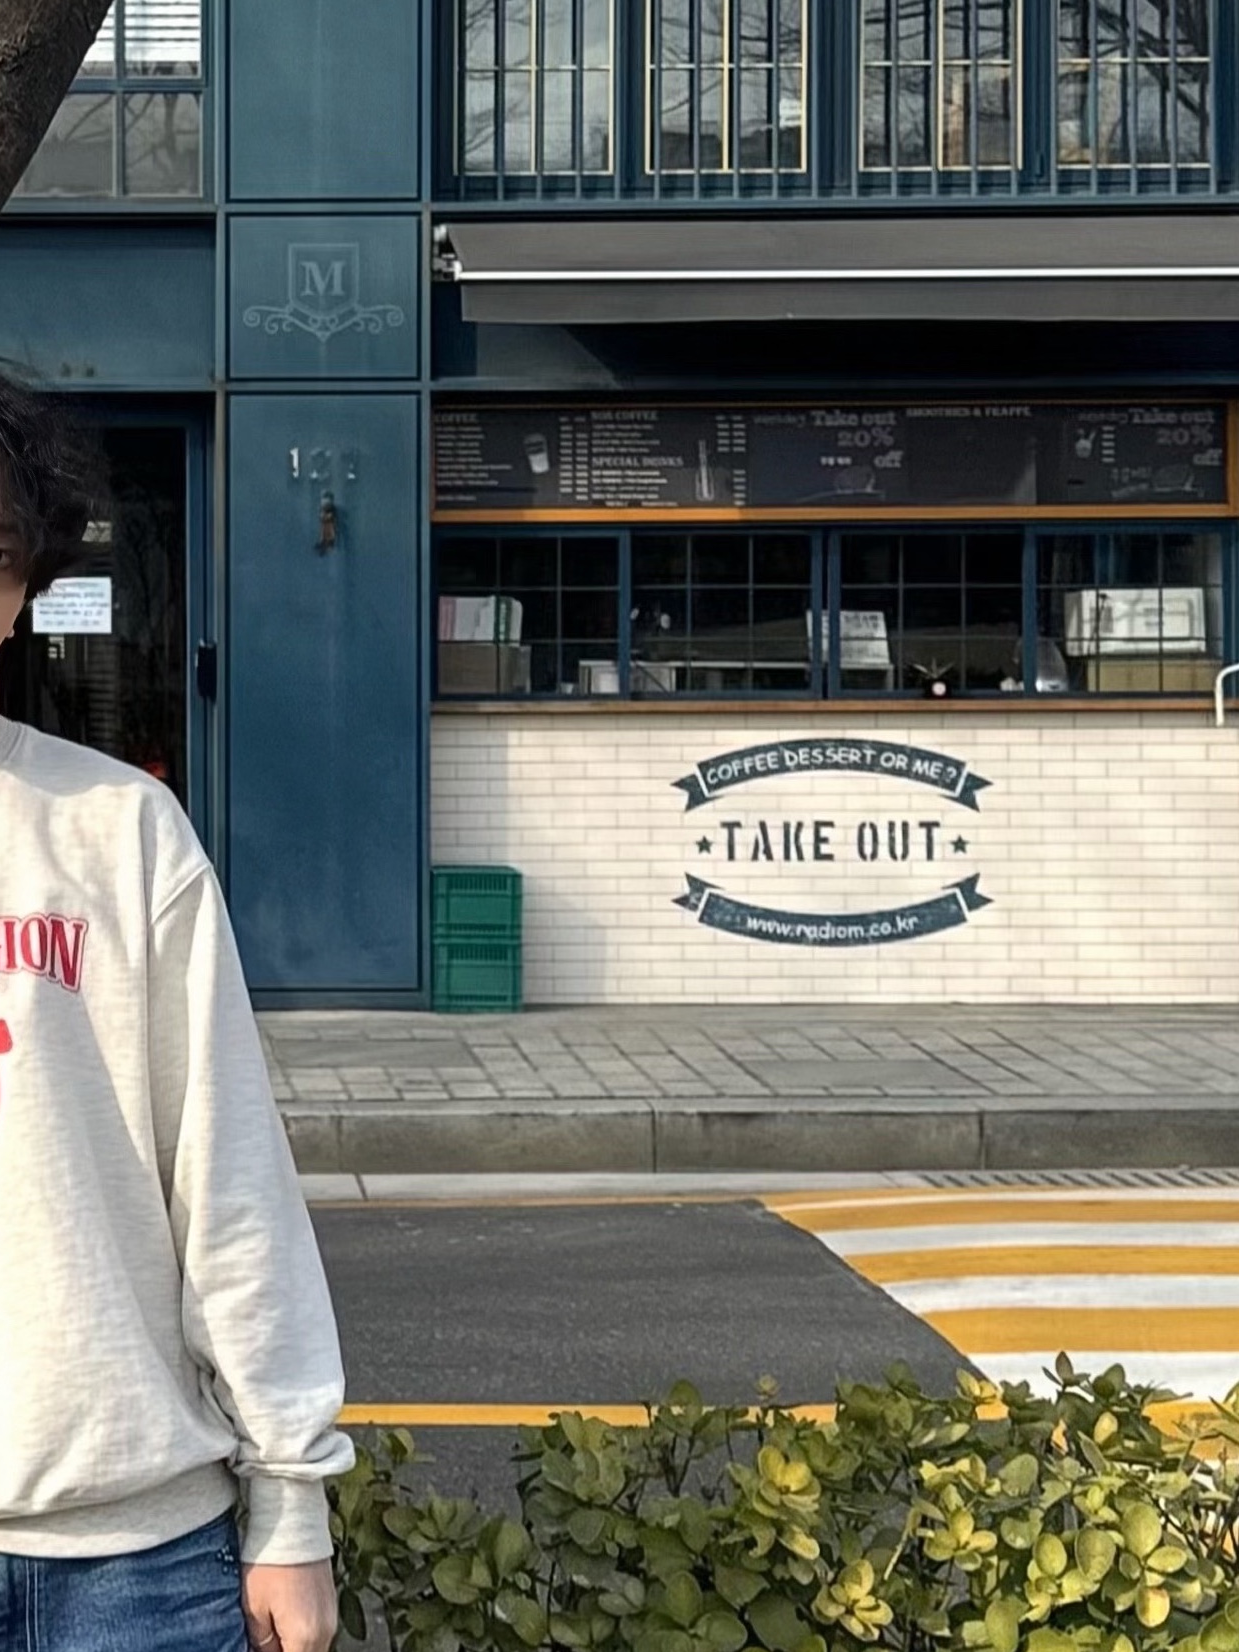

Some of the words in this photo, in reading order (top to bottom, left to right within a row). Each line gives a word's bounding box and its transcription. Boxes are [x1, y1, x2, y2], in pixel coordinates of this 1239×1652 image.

[300, 260, 346, 297] M
[812, 409, 858, 426] Take
[861, 411, 897, 426] out
[837, 427, 894, 447] 20%
[706, 751, 779, 785] COFFEE
[784, 747, 876, 767] DESSERT
[880, 751, 909, 771] OR
[720, 820, 835, 861] TAKE
[857, 820, 941, 861] OUT
